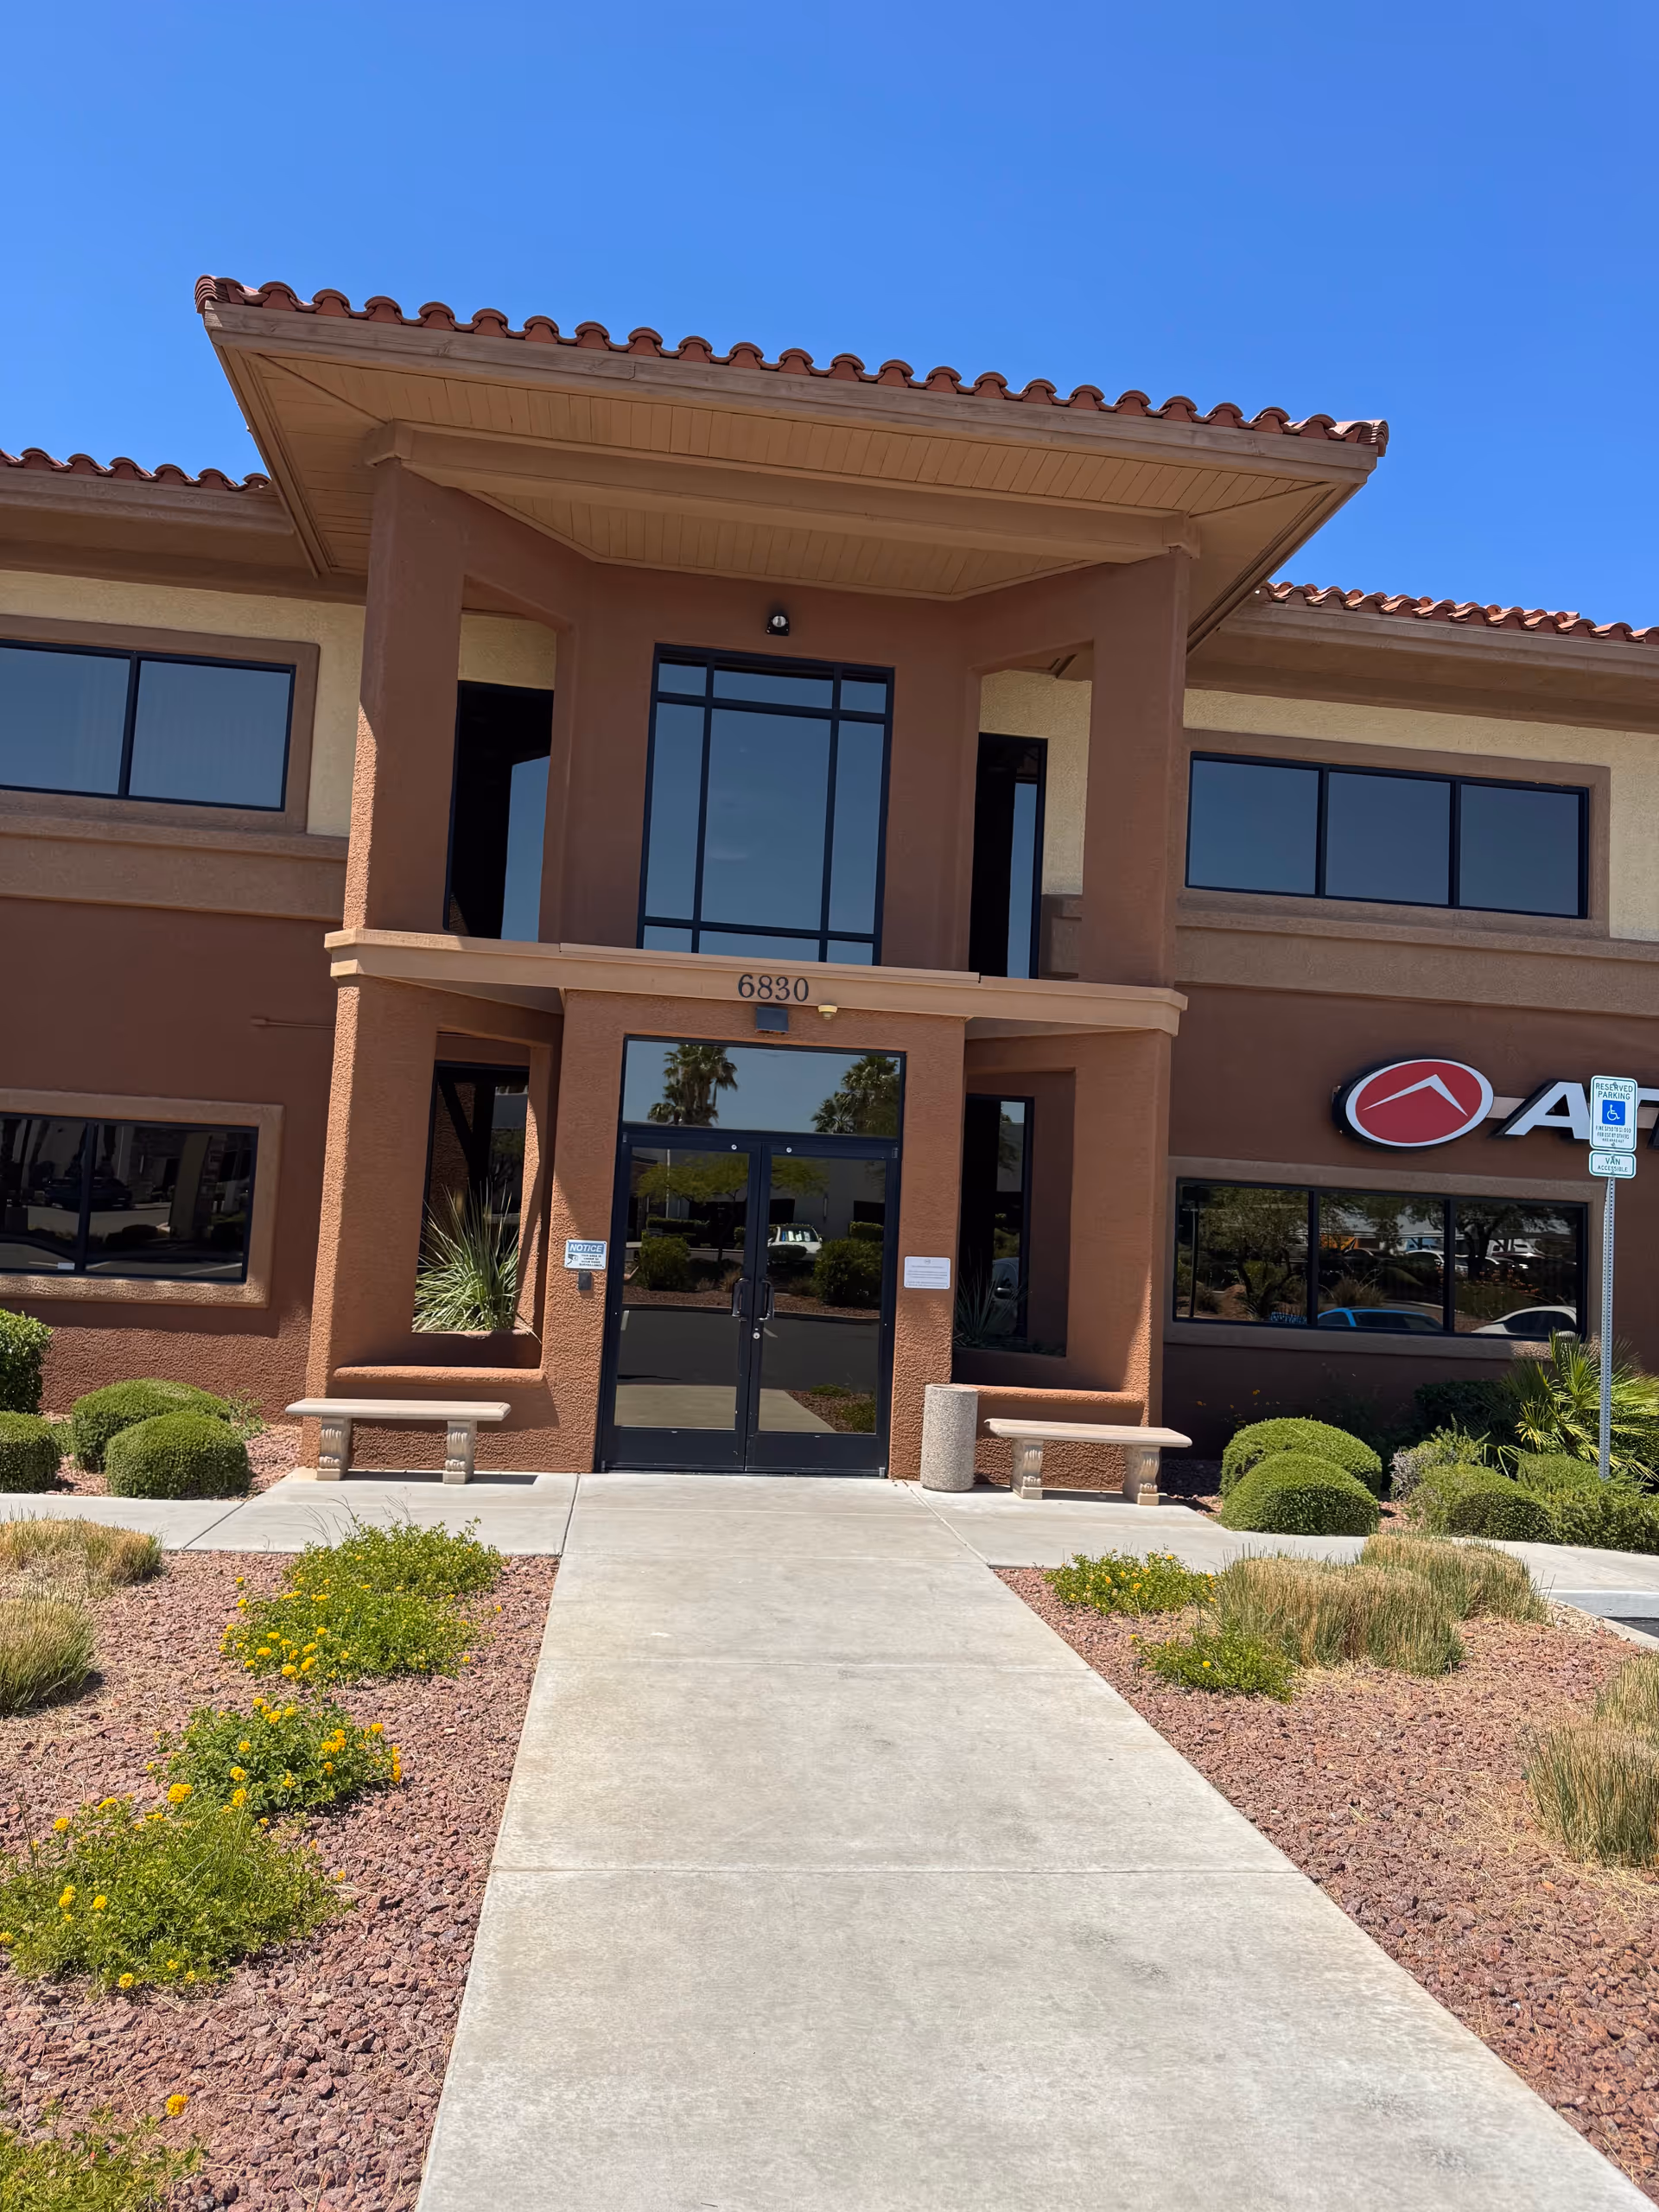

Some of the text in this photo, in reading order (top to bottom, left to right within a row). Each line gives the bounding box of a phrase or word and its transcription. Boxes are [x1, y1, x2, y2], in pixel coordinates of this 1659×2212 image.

[738, 974, 809, 1001] 6830
[1596, 1083, 1633, 1092] RESERVED
[1598, 1091, 1630, 1100] PARKING
